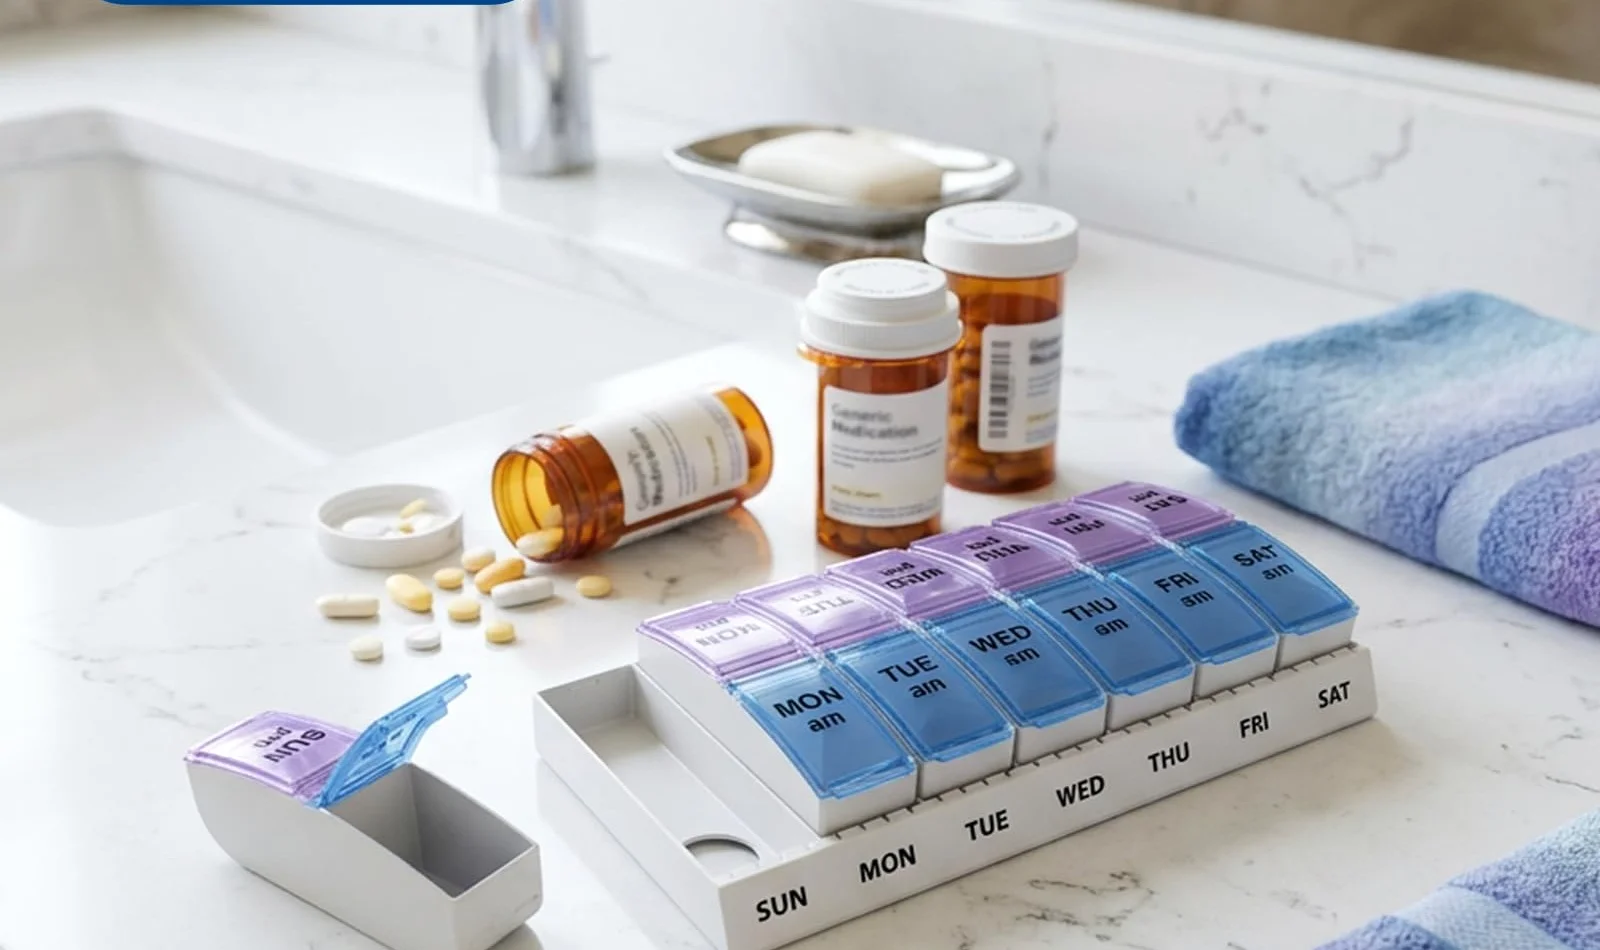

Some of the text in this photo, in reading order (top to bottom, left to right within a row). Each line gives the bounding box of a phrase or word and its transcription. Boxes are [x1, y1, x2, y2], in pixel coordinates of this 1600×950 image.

[831, 402, 893, 424] Generic
[831, 419, 919, 440] Medication
[1233, 544, 1278, 567] SAT
[1153, 571, 1200, 594] FRI
[1061, 596, 1119, 622] THU
[968, 624, 1033, 654] WED
[877, 654, 940, 683] TUE
[909, 677, 947, 699] am
[1318, 680, 1351, 708] SAT
[773, 686, 845, 719] MON
[807, 711, 847, 733] am
[1239, 711, 1270, 739] FRI
[1147, 741, 1191, 773] THU
[1055, 775, 1105, 808] WED
[964, 809, 1010, 841] TUE
[859, 844, 918, 884] MON
[756, 886, 809, 923] SUN
